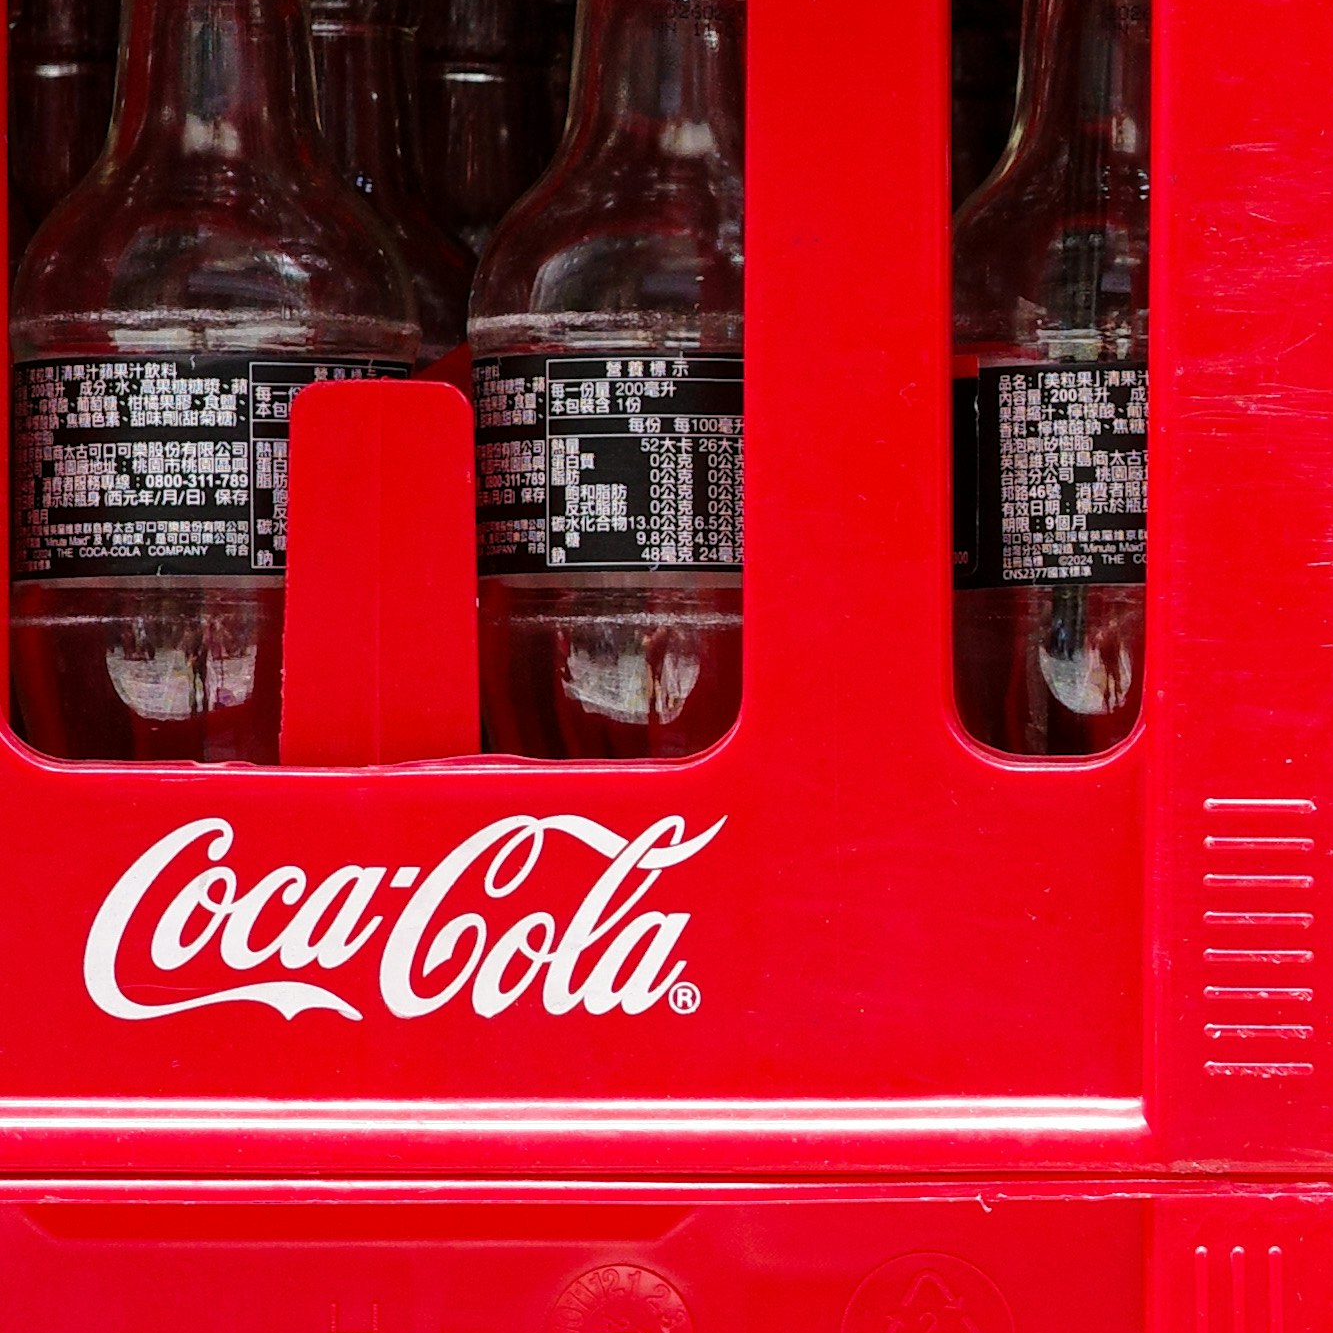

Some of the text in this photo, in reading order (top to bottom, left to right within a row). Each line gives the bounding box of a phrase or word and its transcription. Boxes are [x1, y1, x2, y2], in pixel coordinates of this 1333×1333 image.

[551, 381, 677, 399] 每一份量 200毫升
[617, 397, 642, 413] 1份
[628, 418, 662, 434] 每份
[640, 438, 693, 453] 52大卡
[650, 453, 693, 469] 0公克
[551, 469, 693, 486] 脂肪 0公克
[215, 490, 249, 505] 保存
[565, 484, 693, 501] 飽和脂肪 0公克
[565, 500, 693, 516] 反式脂肪 0公克
[628, 515, 693, 531] 13.0公克
[636, 531, 693, 547] 9.8公克
[148, 546, 209, 557] COMPANY
[641, 546, 693, 563] 48毫克
[1102, 554, 1124, 565] THE
[84, 815, 726, 1020] Coca-Cola
